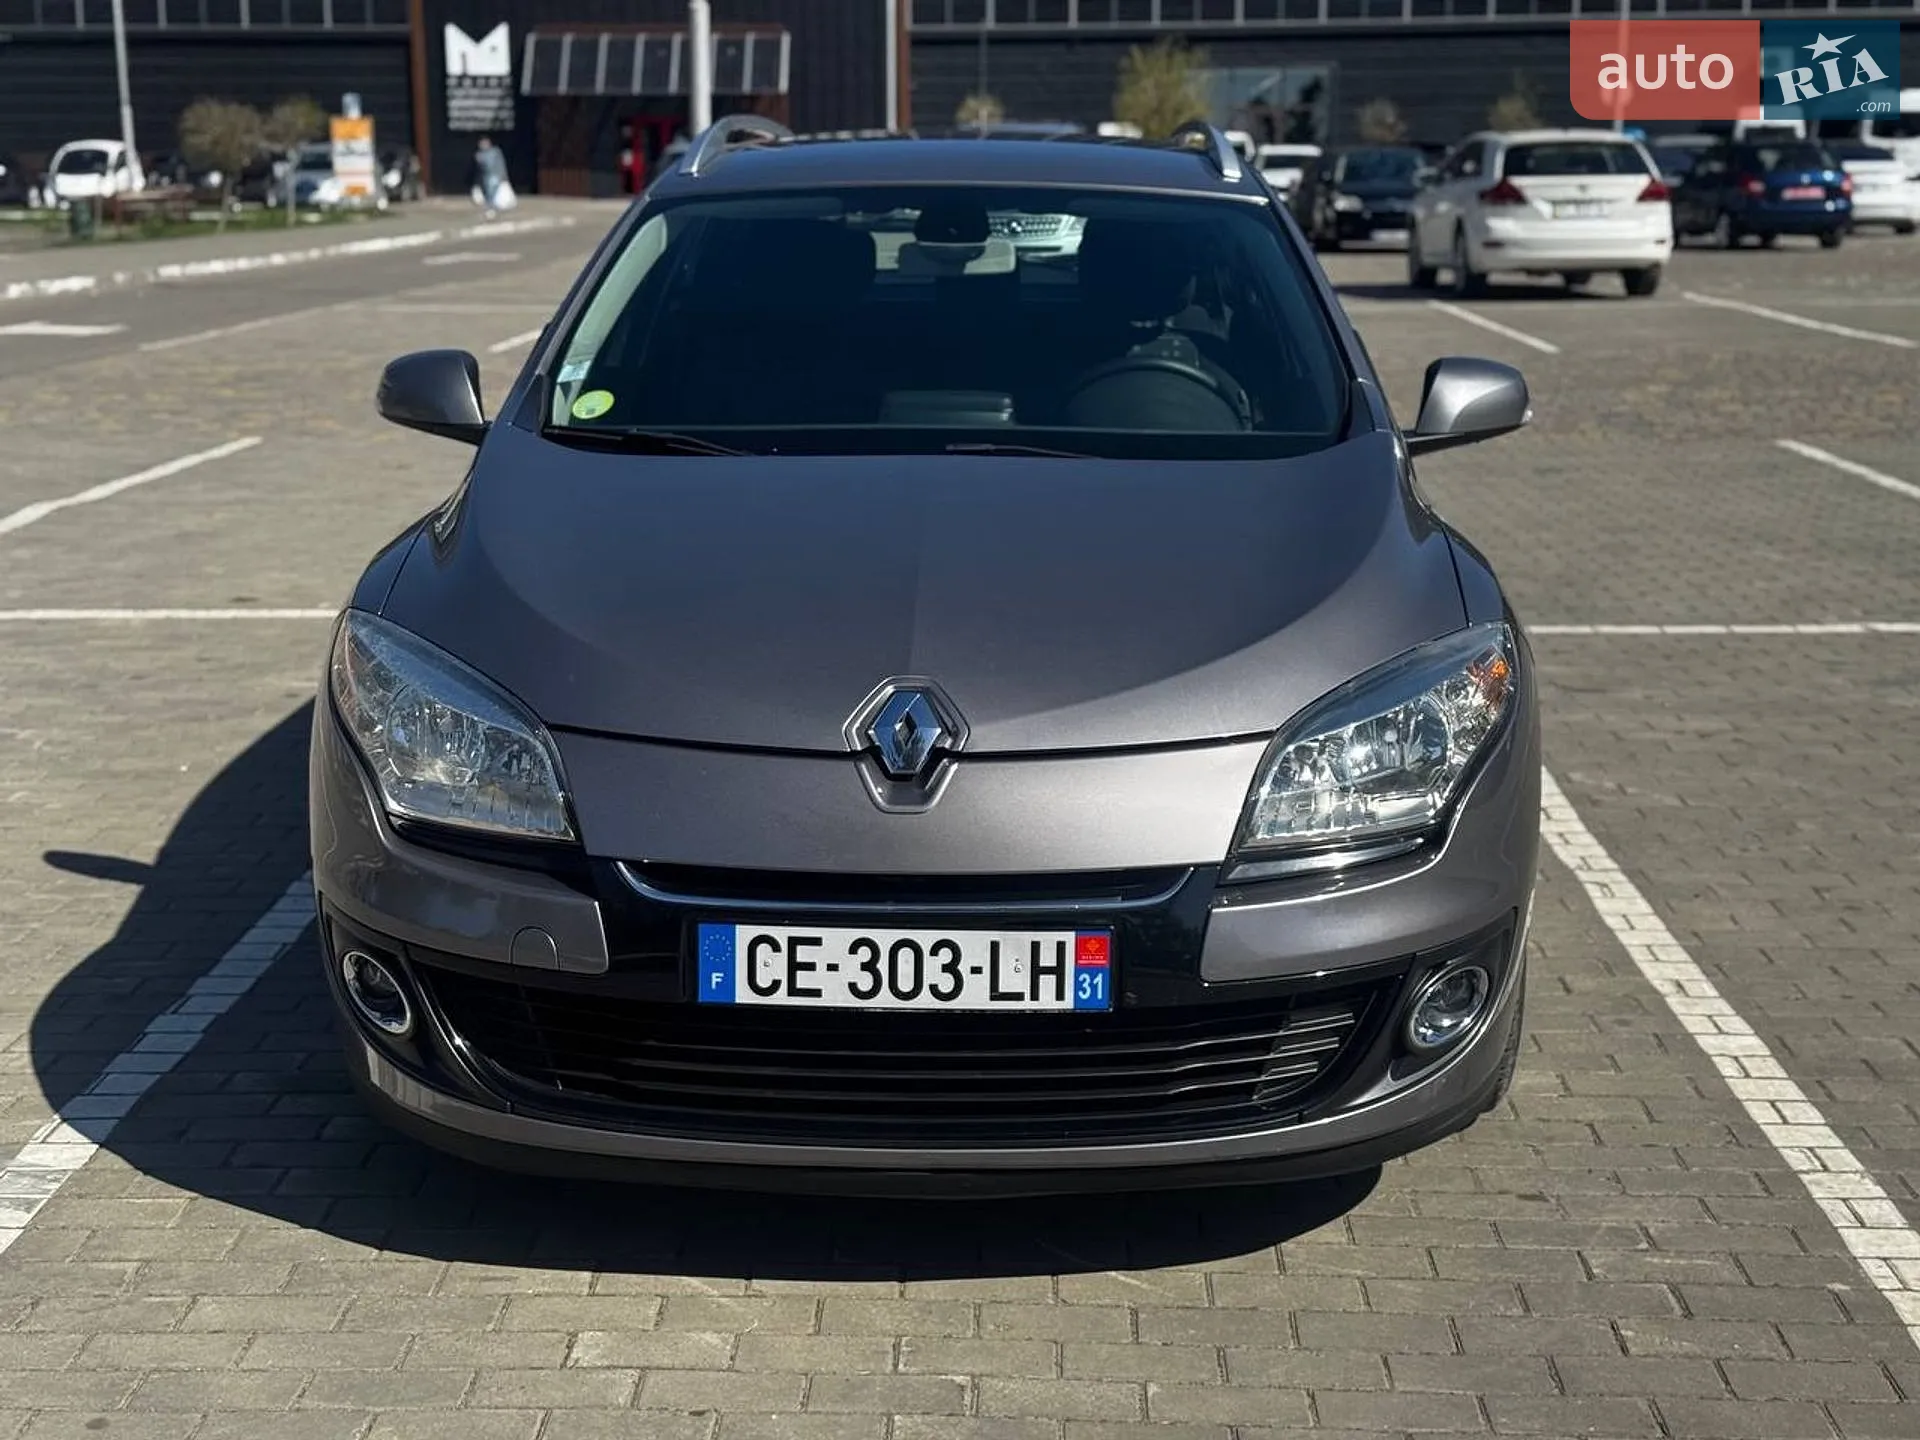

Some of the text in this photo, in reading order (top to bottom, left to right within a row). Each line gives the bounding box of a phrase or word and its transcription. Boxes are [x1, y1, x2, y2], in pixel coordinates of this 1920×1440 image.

[711, 973, 723, 989] F
[747, 934, 1066, 1002] CE-303-LH
[1078, 973, 1103, 1000] 31
